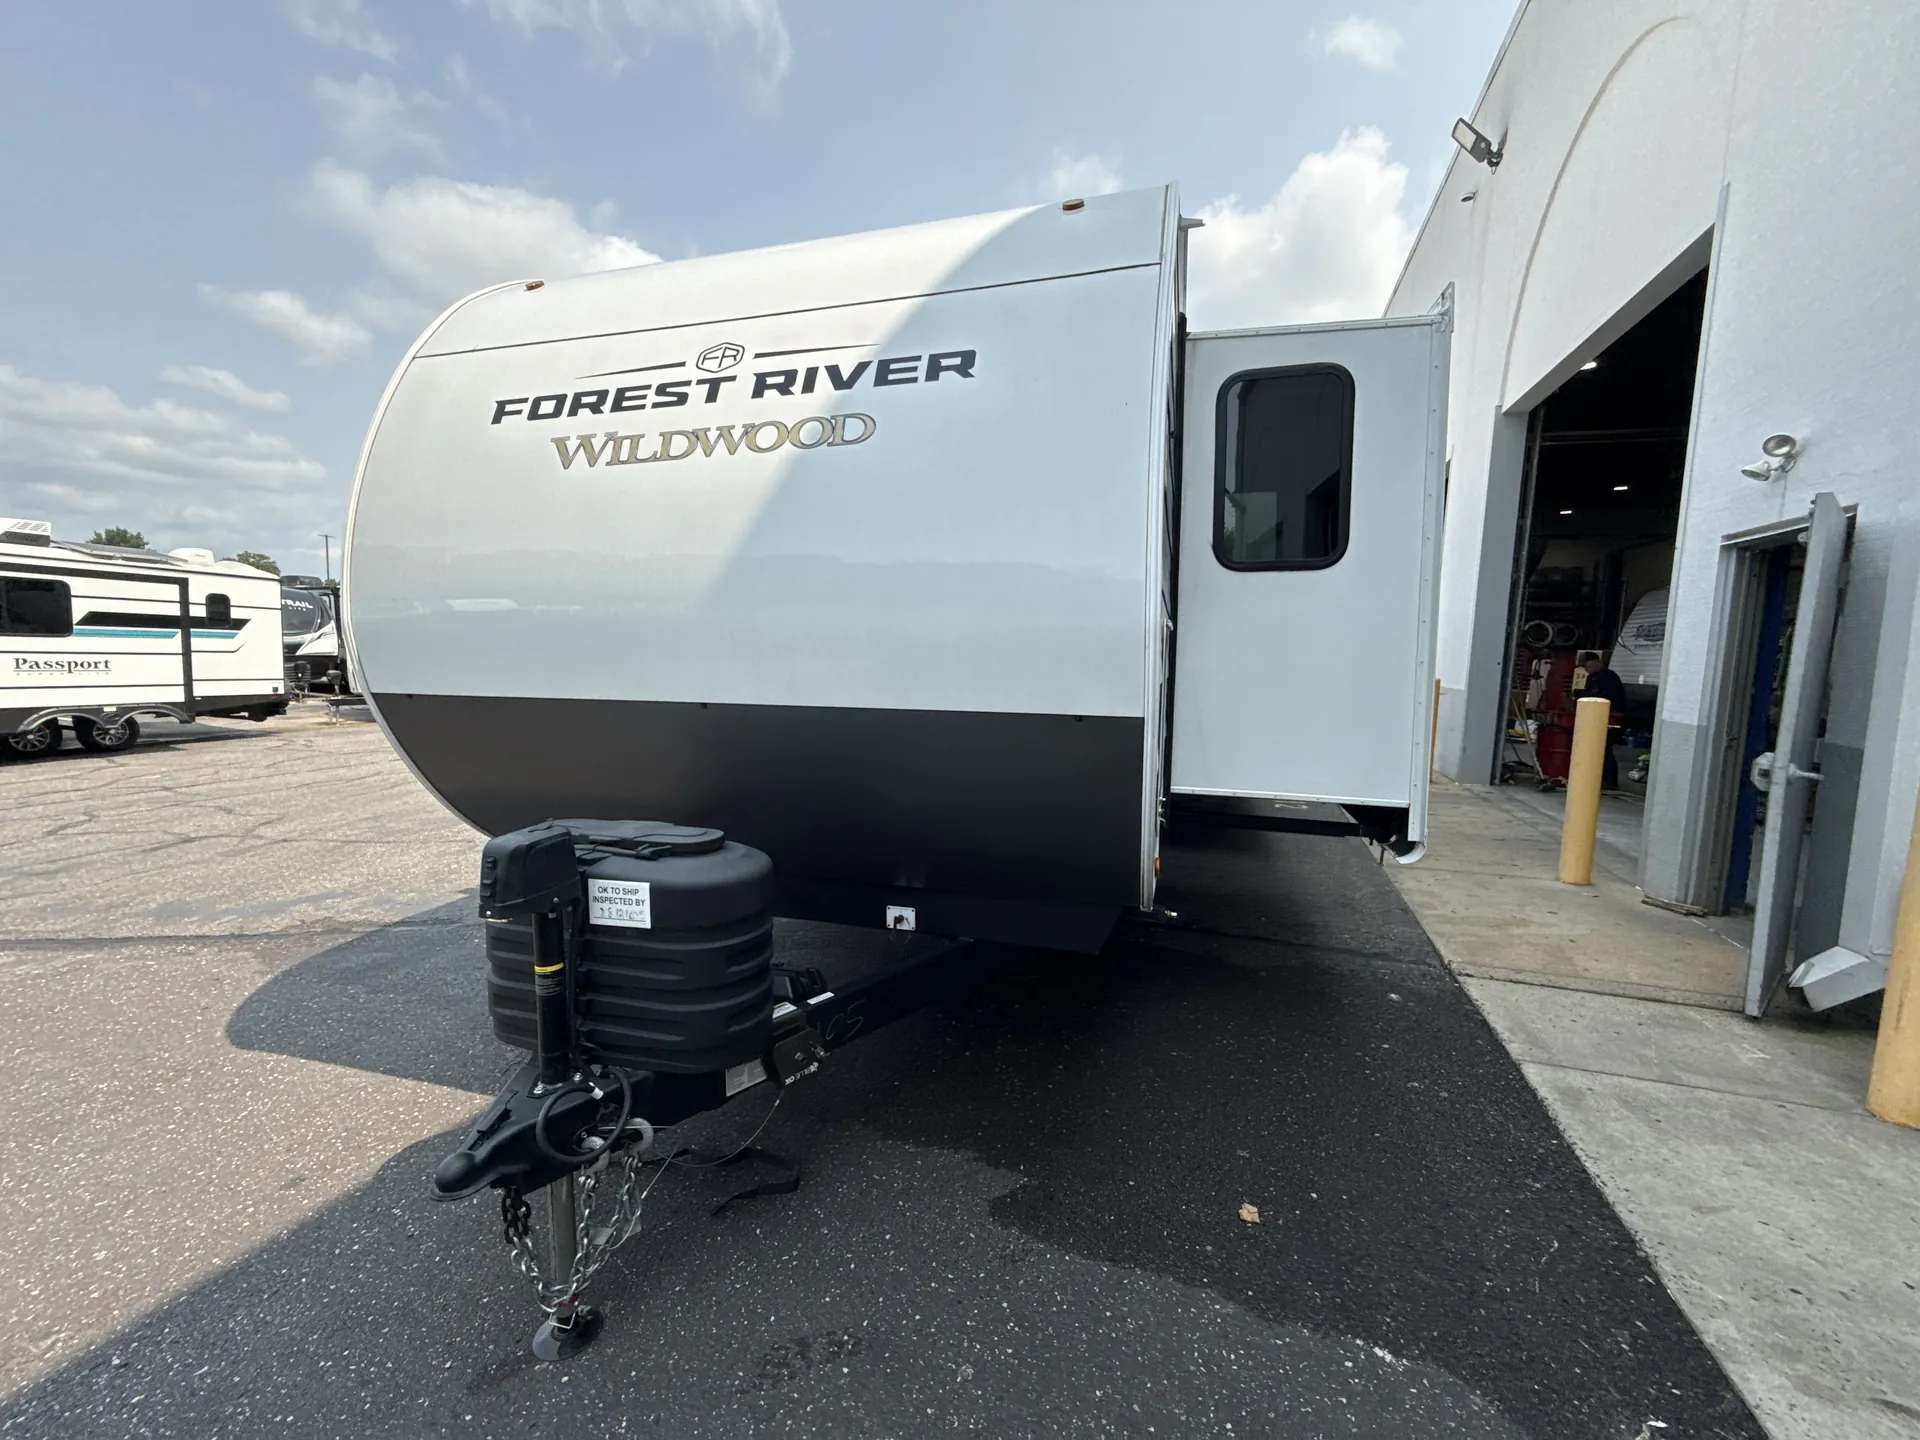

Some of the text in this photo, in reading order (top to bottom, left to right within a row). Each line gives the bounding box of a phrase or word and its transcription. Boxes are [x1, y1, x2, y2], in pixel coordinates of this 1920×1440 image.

[491, 350, 976, 425] FOREST RIVER
[551, 413, 876, 469] WILDWOOD
[13, 657, 111, 673] Passport
[598, 886, 639, 896] OK TO SHIP
[592, 895, 633, 905] INSPECTED
